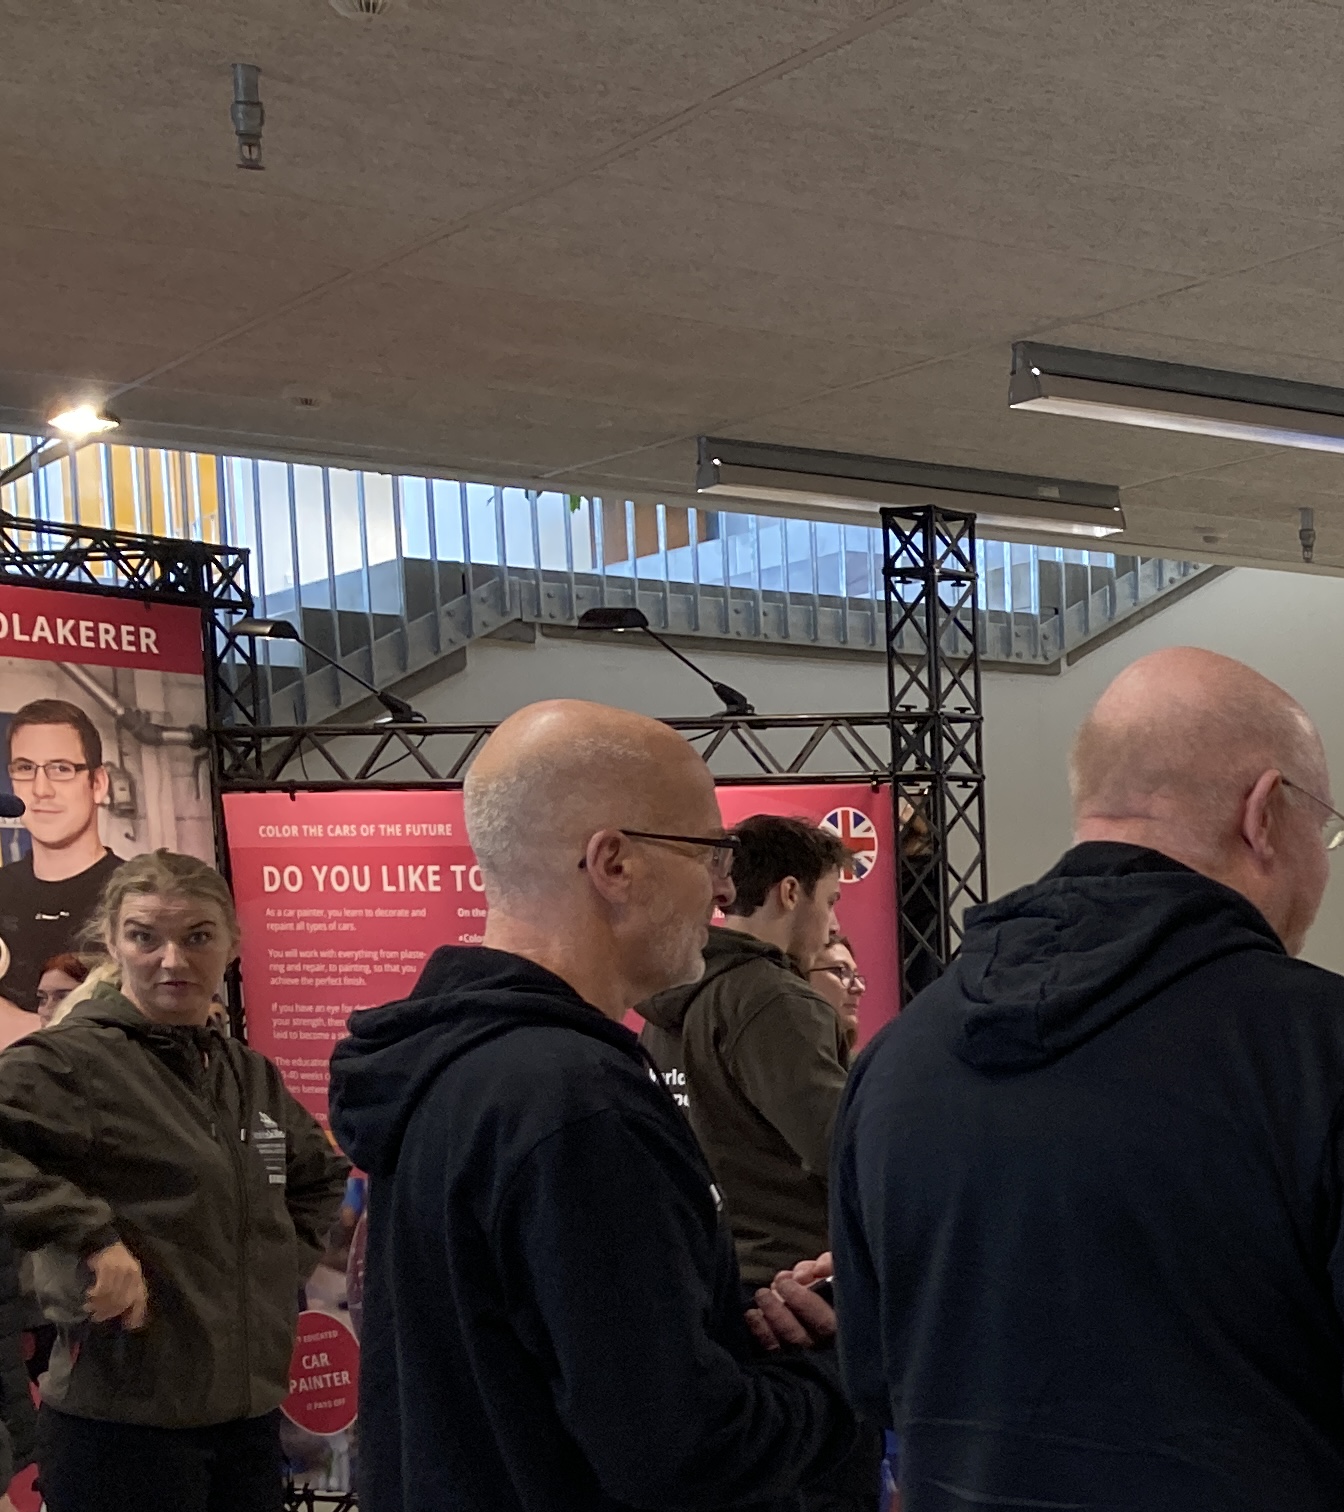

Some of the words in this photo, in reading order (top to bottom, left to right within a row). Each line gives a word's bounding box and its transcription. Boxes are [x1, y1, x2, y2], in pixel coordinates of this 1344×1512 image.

[258, 825, 299, 838] COLOR
[302, 825, 324, 837] THE
[327, 825, 357, 837] CARS
[360, 824, 376, 837] OF
[378, 824, 402, 836] THE
[405, 823, 453, 836] FUTURE
[262, 865, 303, 893] DO
[311, 865, 371, 893] YOU
[381, 864, 442, 893] LIKE
[450, 864, 486, 892] TO
[282, 909, 295, 917] car
[327, 909, 342, 919] you
[364, 908, 374, 917] to
[374, 907, 410, 917] decorate
[410, 907, 427, 917] and
[457, 907, 471, 918] On
[471, 907, 487, 918] the
[305, 922, 327, 933] types
[267, 948, 284, 958] You
[299, 948, 319, 958] work
[319, 948, 337, 958] with
[337, 948, 379, 961] everything
[379, 948, 400, 959] from
[286, 962, 302, 972] and
[328, 963, 338, 972] to
[373, 964, 383, 973] so
[383, 963, 400, 973] that
[401, 965, 417, 975] you
[300, 975, 314, 986] the
[314, 975, 342, 987] perfect
[278, 1004, 294, 1014] you
[294, 1003, 314, 1013] have
[326, 1004, 340, 1015] eye
[288, 1030, 299, 1039] to
[299, 1029, 330, 1040] become
[275, 1056, 291, 1067] The
[302, 1352, 331, 1370] CAR
[289, 1370, 351, 1394] PAINTER
